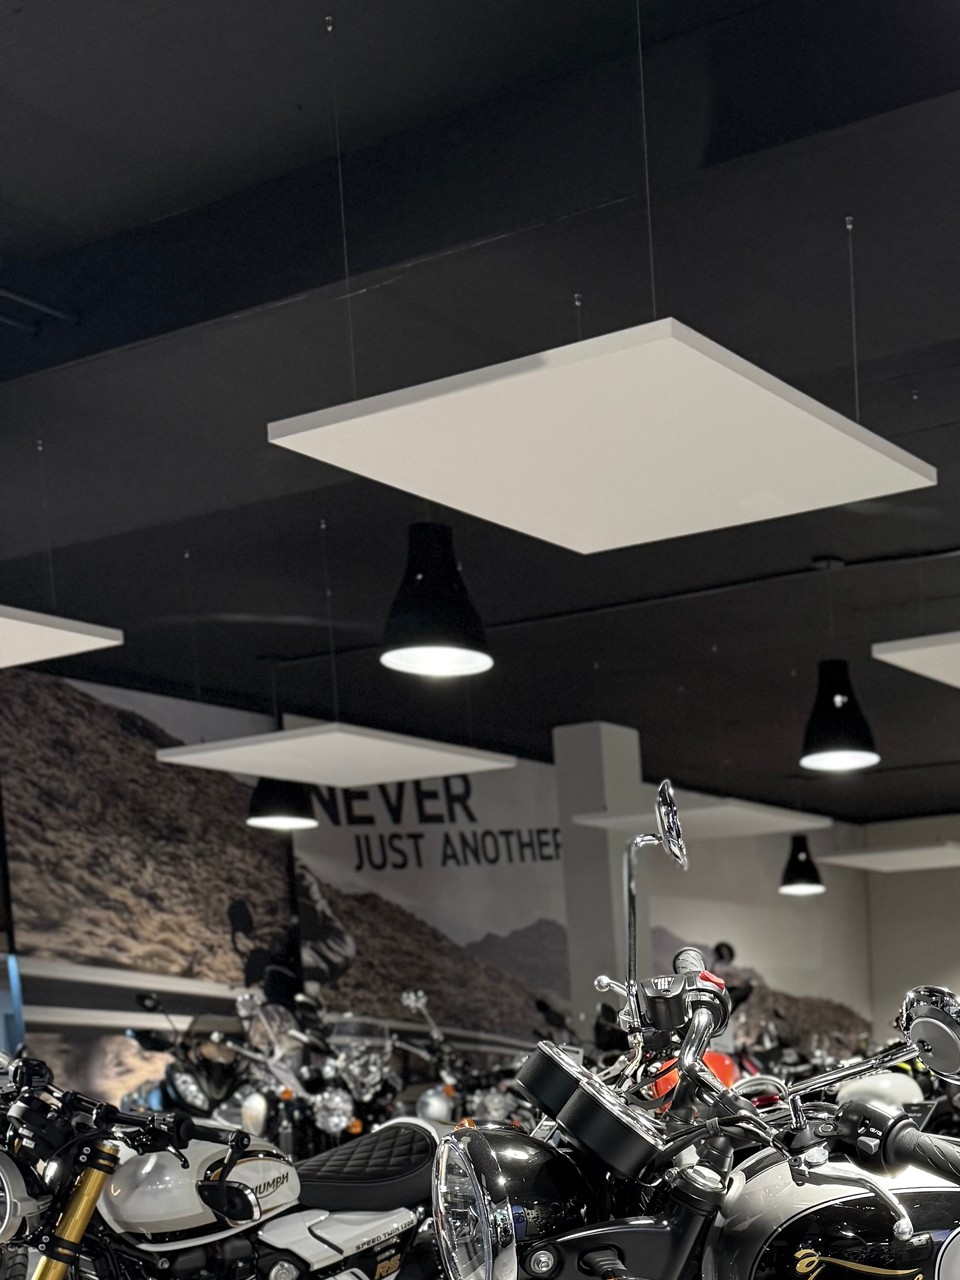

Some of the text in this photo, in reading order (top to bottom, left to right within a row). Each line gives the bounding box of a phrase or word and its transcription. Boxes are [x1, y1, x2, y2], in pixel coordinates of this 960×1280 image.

[308, 774, 477, 827] NEVER
[354, 833, 425, 873] JUST
[250, 1172, 289, 1197] IUMPH
[355, 1235, 382, 1251] SPEED
[383, 1226, 400, 1239] TWIN
[401, 1219, 415, 1231] 1200
[374, 1254, 401, 1280] RS
